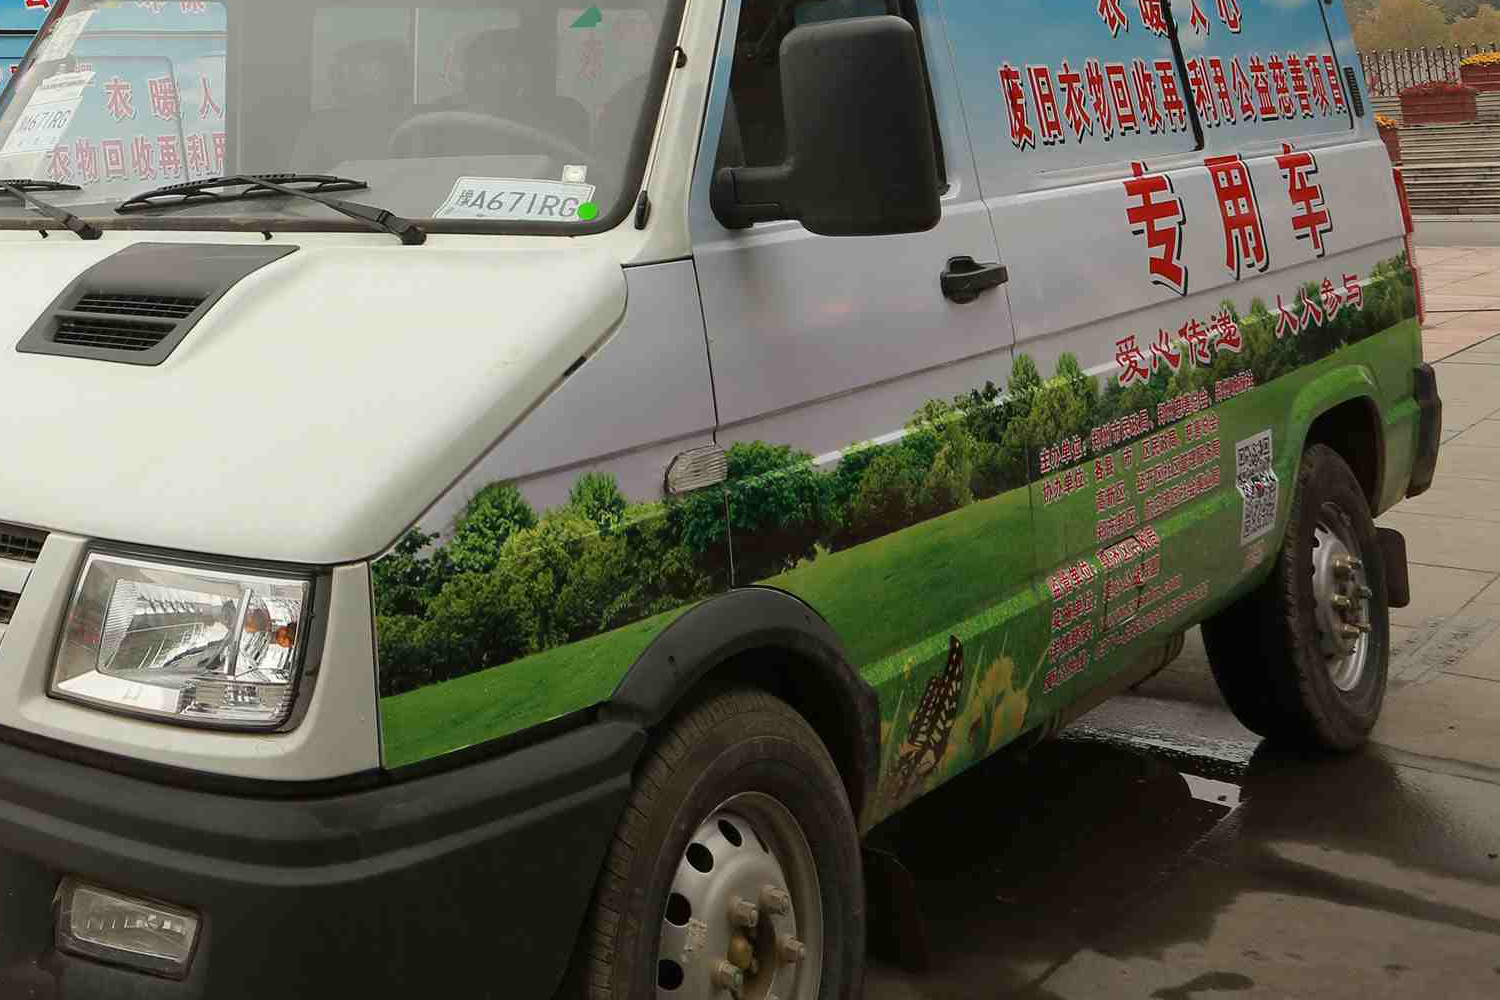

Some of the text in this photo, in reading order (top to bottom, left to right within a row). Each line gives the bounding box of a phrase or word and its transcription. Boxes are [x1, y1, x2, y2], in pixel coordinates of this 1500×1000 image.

[999, 52, 1347, 151] 废旧衣物回收再利用公益慈善项目
[1123, 142, 1333, 297] 专用车
[1114, 273, 1365, 385] 爱心传递 人人参与
